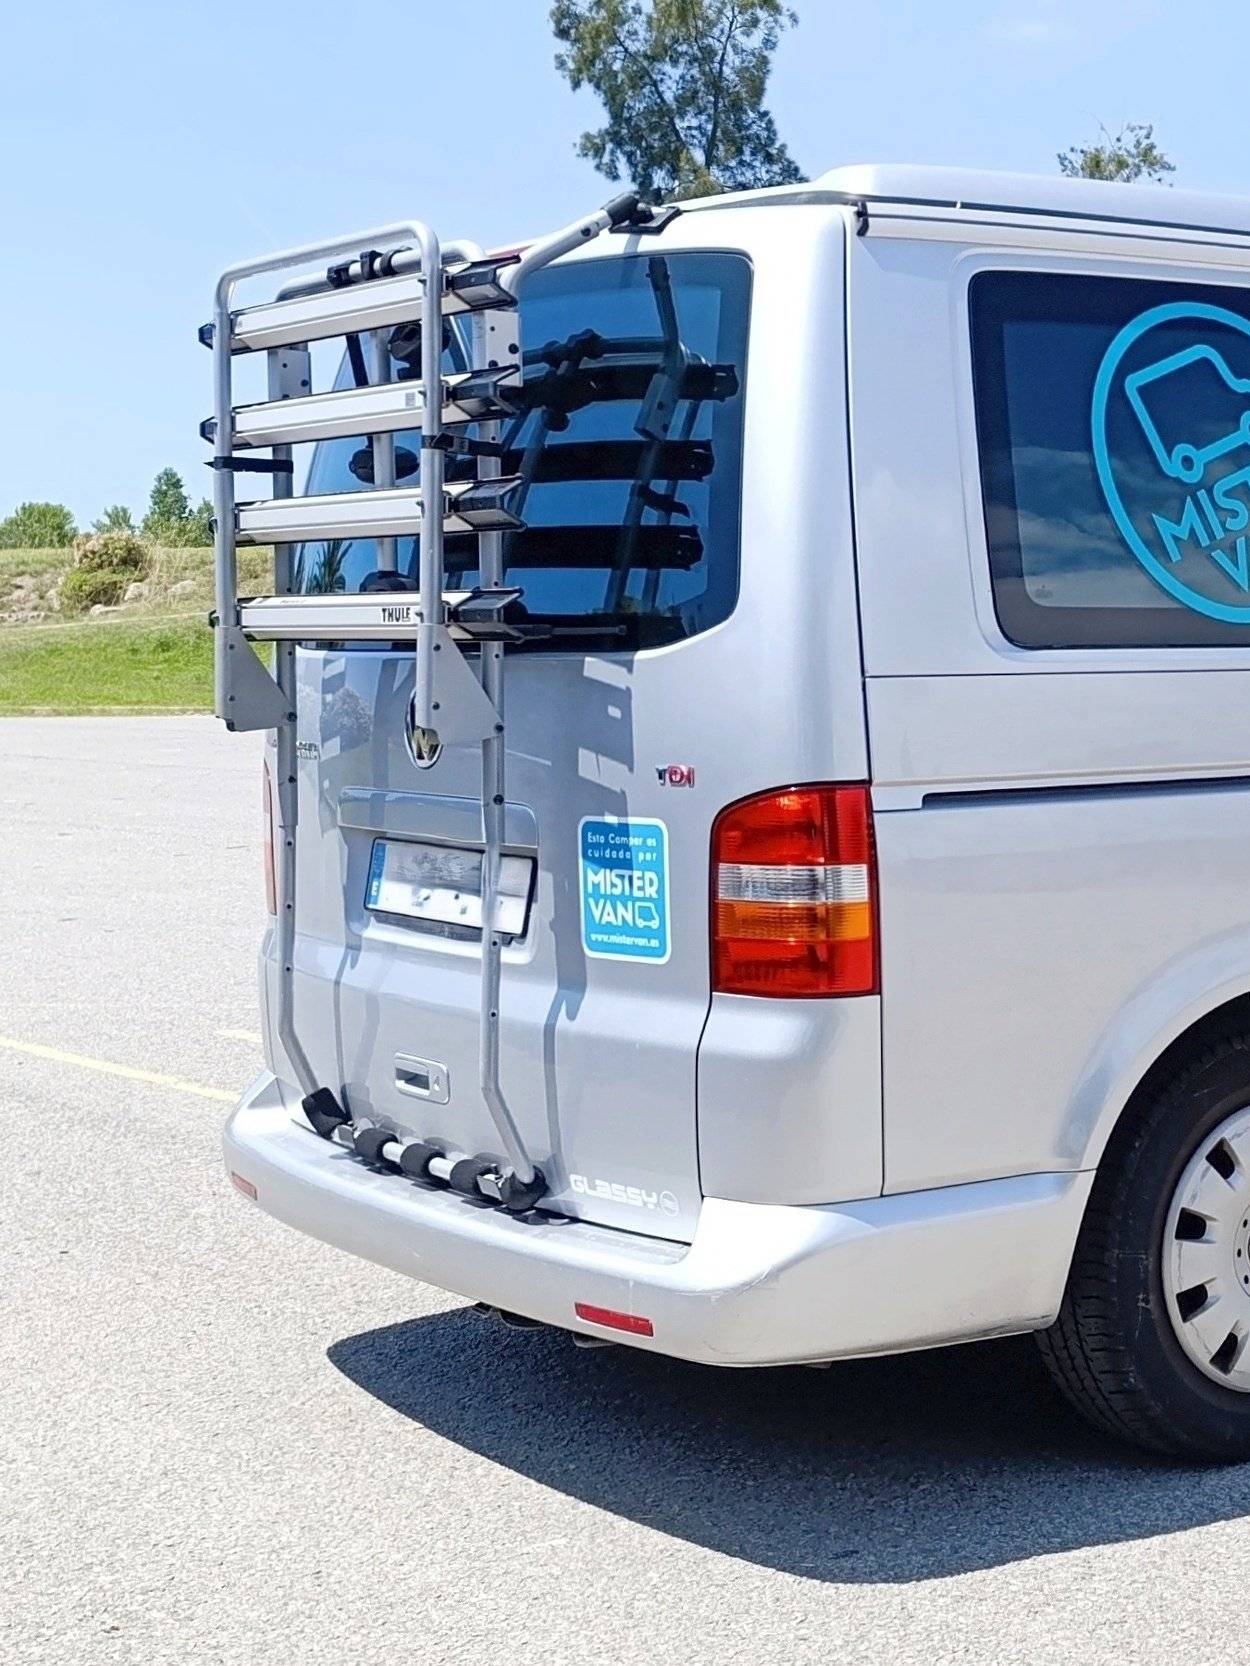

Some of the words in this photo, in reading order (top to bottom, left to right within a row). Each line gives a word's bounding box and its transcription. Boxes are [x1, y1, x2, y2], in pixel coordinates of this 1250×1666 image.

[381, 606, 411, 623] THULE
[655, 764, 695, 788] TDI
[608, 833, 644, 848] Camper
[638, 851, 657, 863] por
[586, 867, 659, 899] MISTER
[588, 897, 634, 927] VAN
[590, 932, 660, 948] www.mistervan.es
